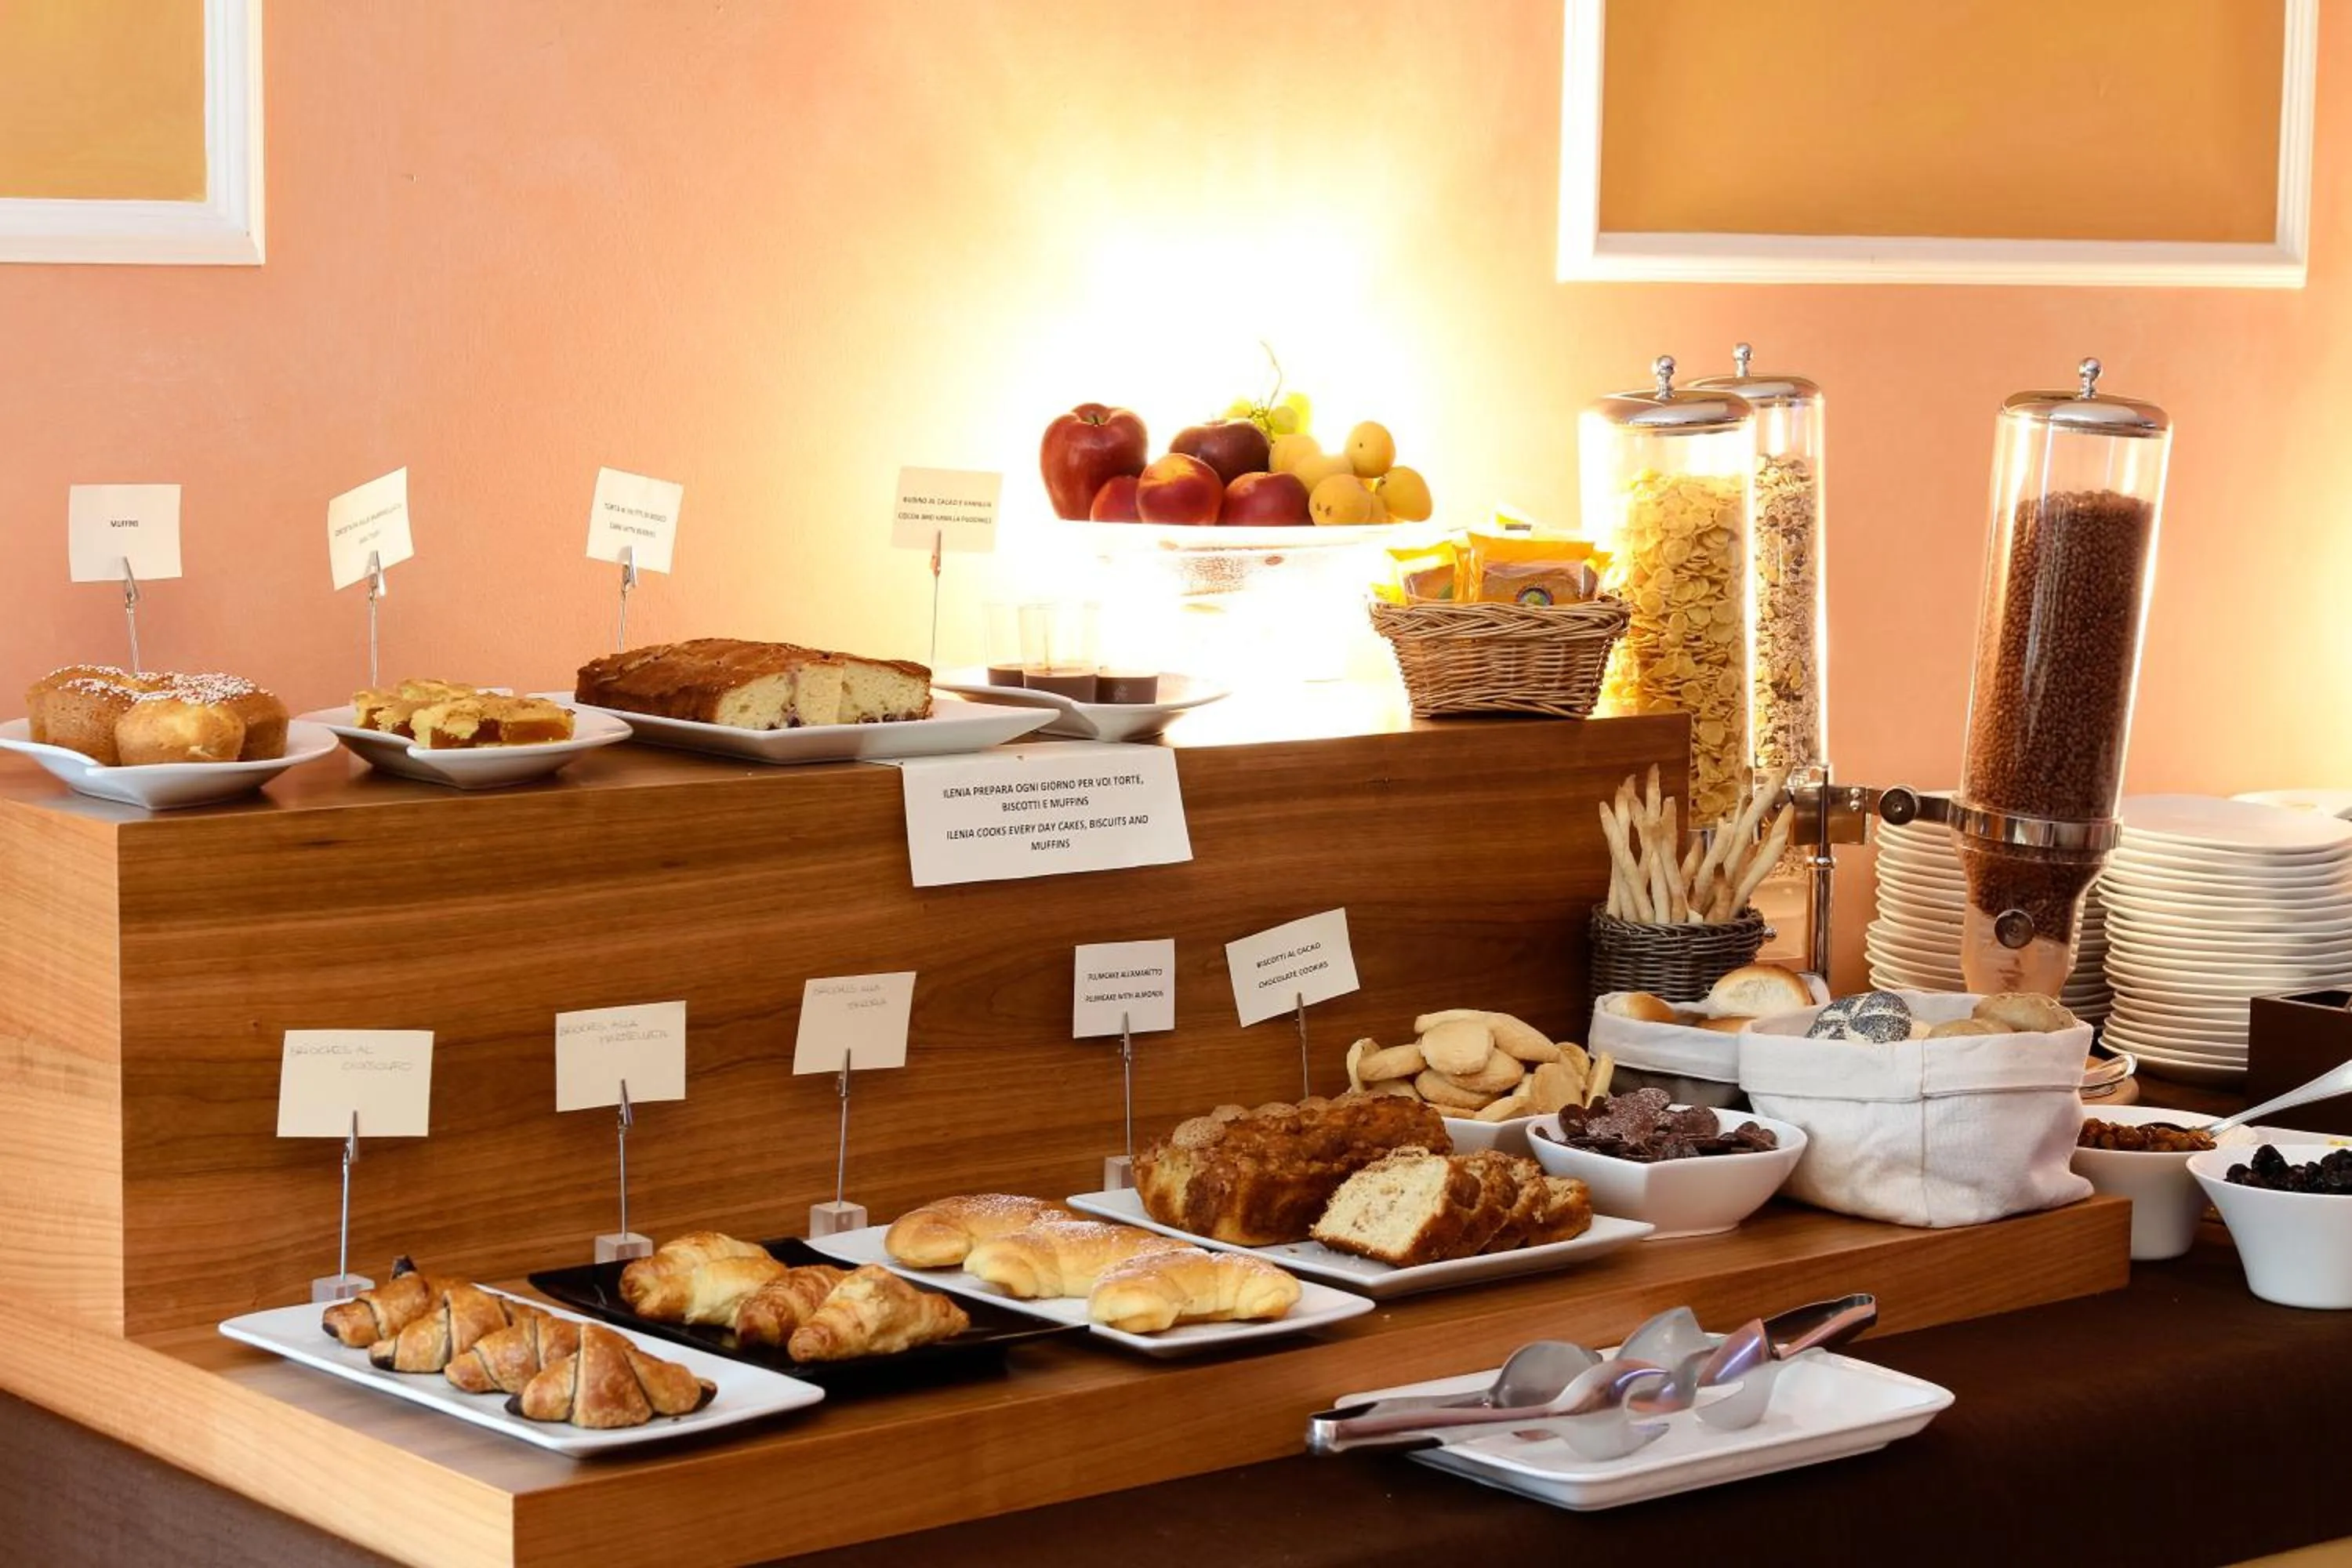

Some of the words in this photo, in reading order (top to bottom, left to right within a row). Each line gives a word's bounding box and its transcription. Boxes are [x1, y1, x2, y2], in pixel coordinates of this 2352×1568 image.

[943, 787, 971, 799] ILENIA
[973, 785, 1014, 796] PREPARA
[1015, 782, 1039, 793] OGNI
[1040, 780, 1076, 791] GIORNO
[1078, 779, 1094, 789] PER
[1095, 777, 1111, 787] VOI
[1113, 775, 1144, 786] TORTE,
[1002, 800, 1040, 811] BISCOTTI
[1043, 799, 1048, 809] E
[1050, 797, 1089, 808] MUFFINS
[946, 828, 975, 840] ILENIA
[976, 826, 1007, 837] COOKS
[1009, 823, 1036, 836] EVERY
[1037, 822, 1056, 833] DAY
[1058, 820, 1087, 831] CAKES,
[1089, 816, 1127, 829] BISCUITS
[1129, 815, 1149, 825] AND
[1031, 838, 1070, 851] MUFFINS
[1257, 953, 1287, 968] BISCOTTI
[1287, 949, 1296, 958] AL
[1297, 942, 1321, 955] CACAO
